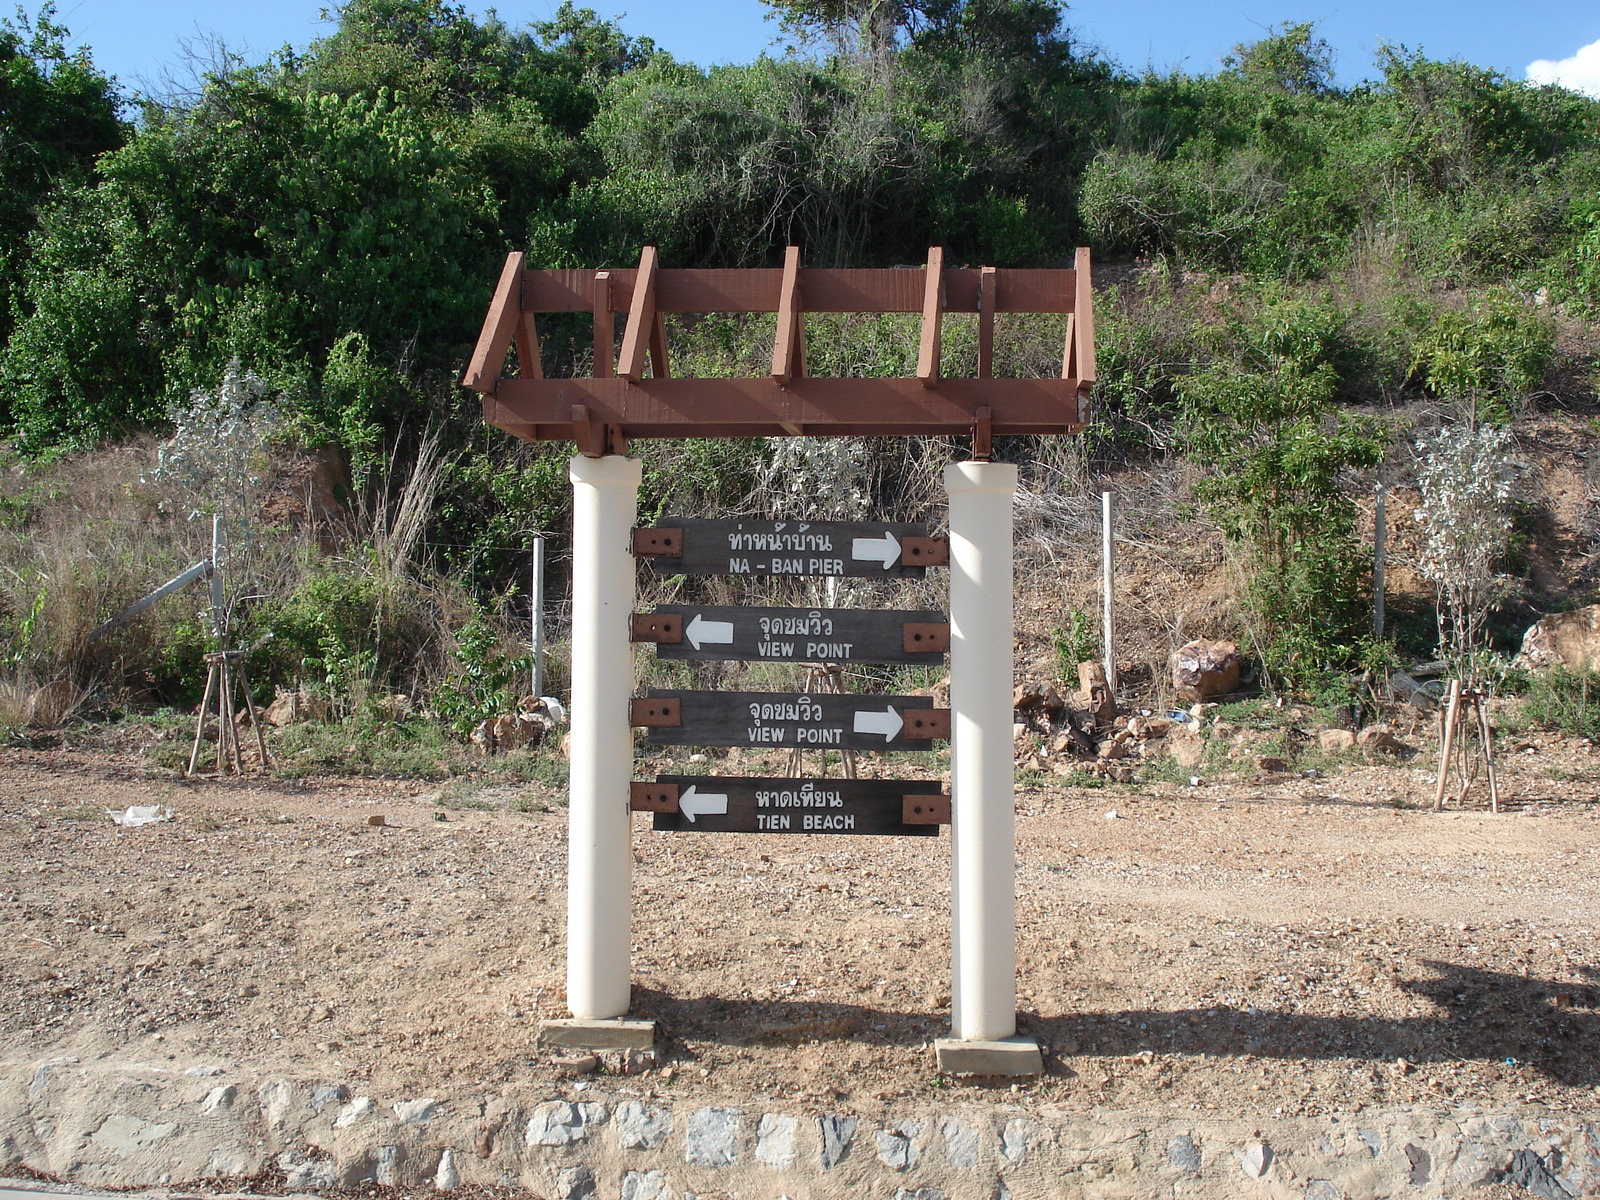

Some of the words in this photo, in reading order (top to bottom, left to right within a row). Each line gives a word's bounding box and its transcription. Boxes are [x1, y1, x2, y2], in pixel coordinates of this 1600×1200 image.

[728, 522, 833, 552] ท่าหน้าบ้าน
[729, 558, 750, 574] NA
[772, 558, 803, 575] BAN
[809, 559, 843, 575] PIER
[759, 611, 833, 640] จุดชมวิว
[757, 642, 795, 657] VIEW
[806, 642, 853, 659] POINT
[749, 696, 823, 725] จุดชมวิว
[748, 727, 785, 743] VIEW
[797, 728, 843, 744] POINT
[755, 783, 843, 809] หาดเทียน
[757, 814, 790, 830] TIEN
[803, 814, 855, 830] BEACH
